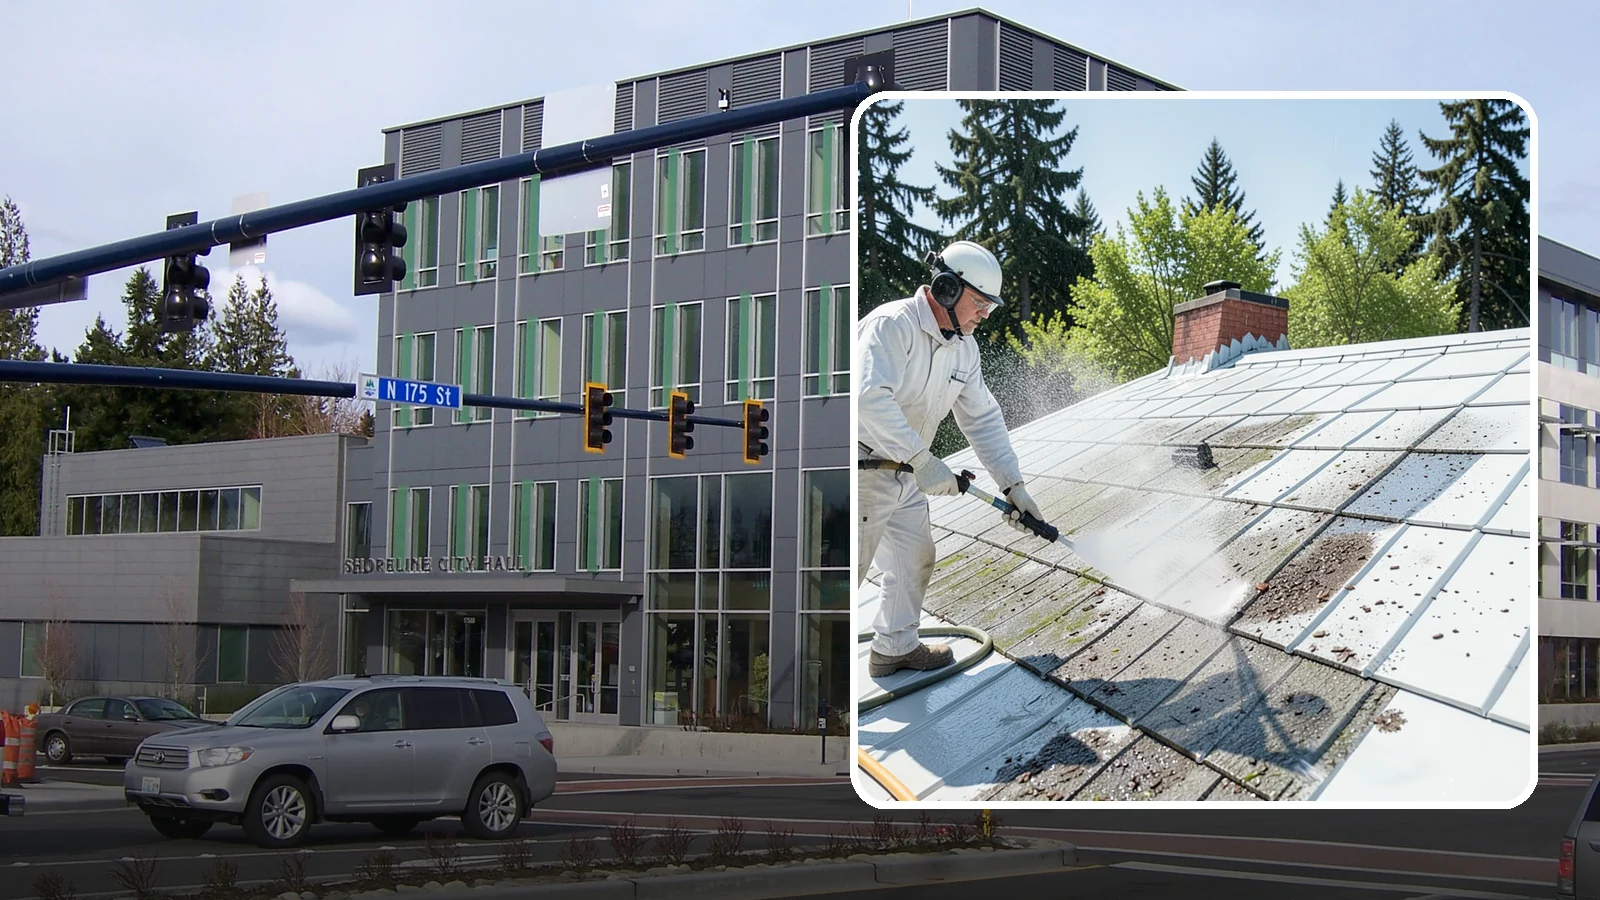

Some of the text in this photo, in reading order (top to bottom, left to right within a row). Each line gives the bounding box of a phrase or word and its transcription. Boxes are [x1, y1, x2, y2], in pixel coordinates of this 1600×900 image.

[387, 380, 452, 406] N 175 St
[344, 555, 526, 574] SHORELINE CITY HALL
